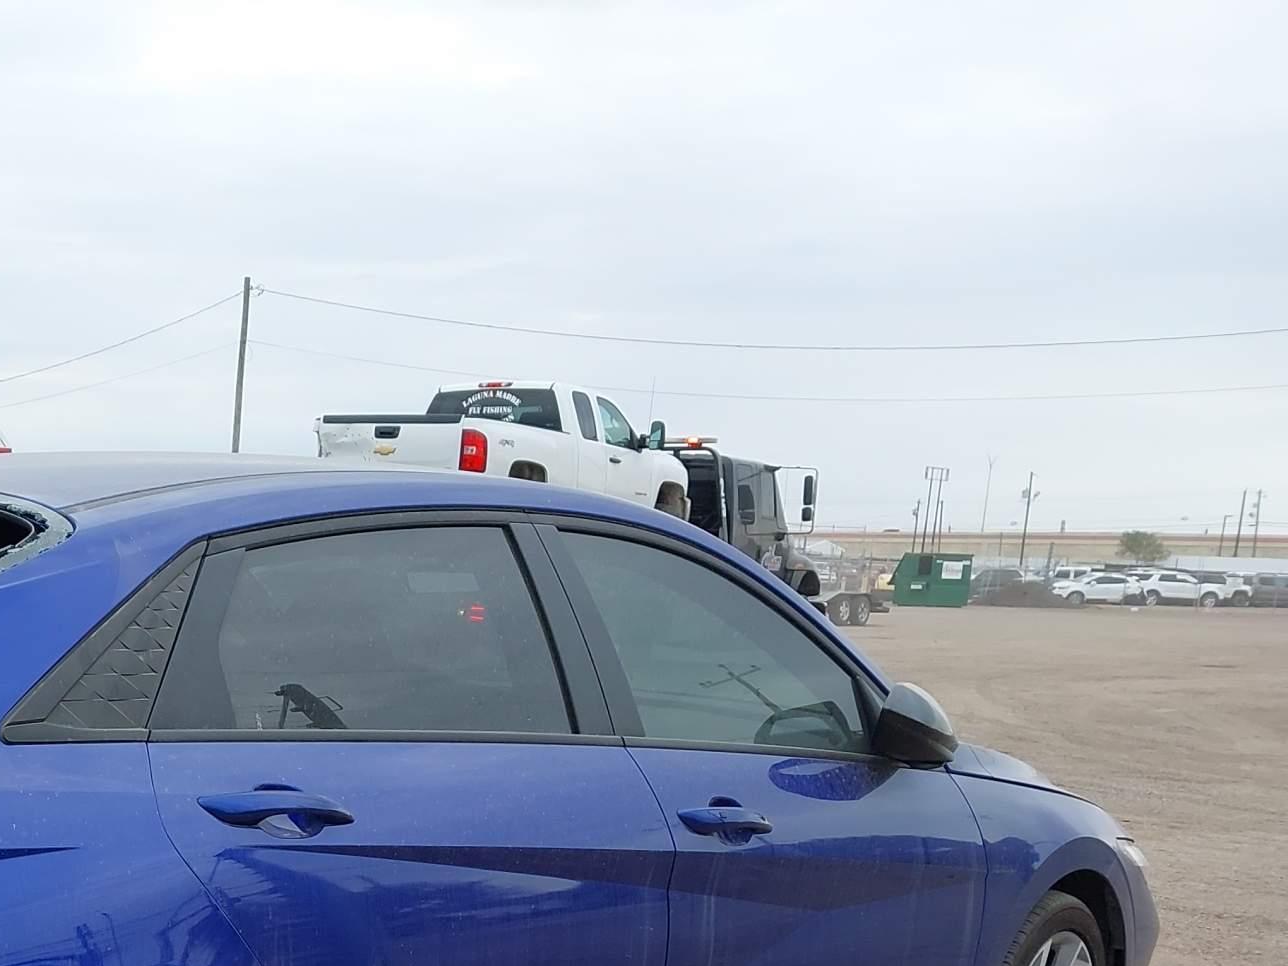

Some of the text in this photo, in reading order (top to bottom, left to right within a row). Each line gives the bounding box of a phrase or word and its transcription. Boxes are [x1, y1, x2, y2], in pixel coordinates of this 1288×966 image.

[462, 390, 521, 407] LAGUNA MADRE
[469, 406, 513, 415] FLY FISHING
